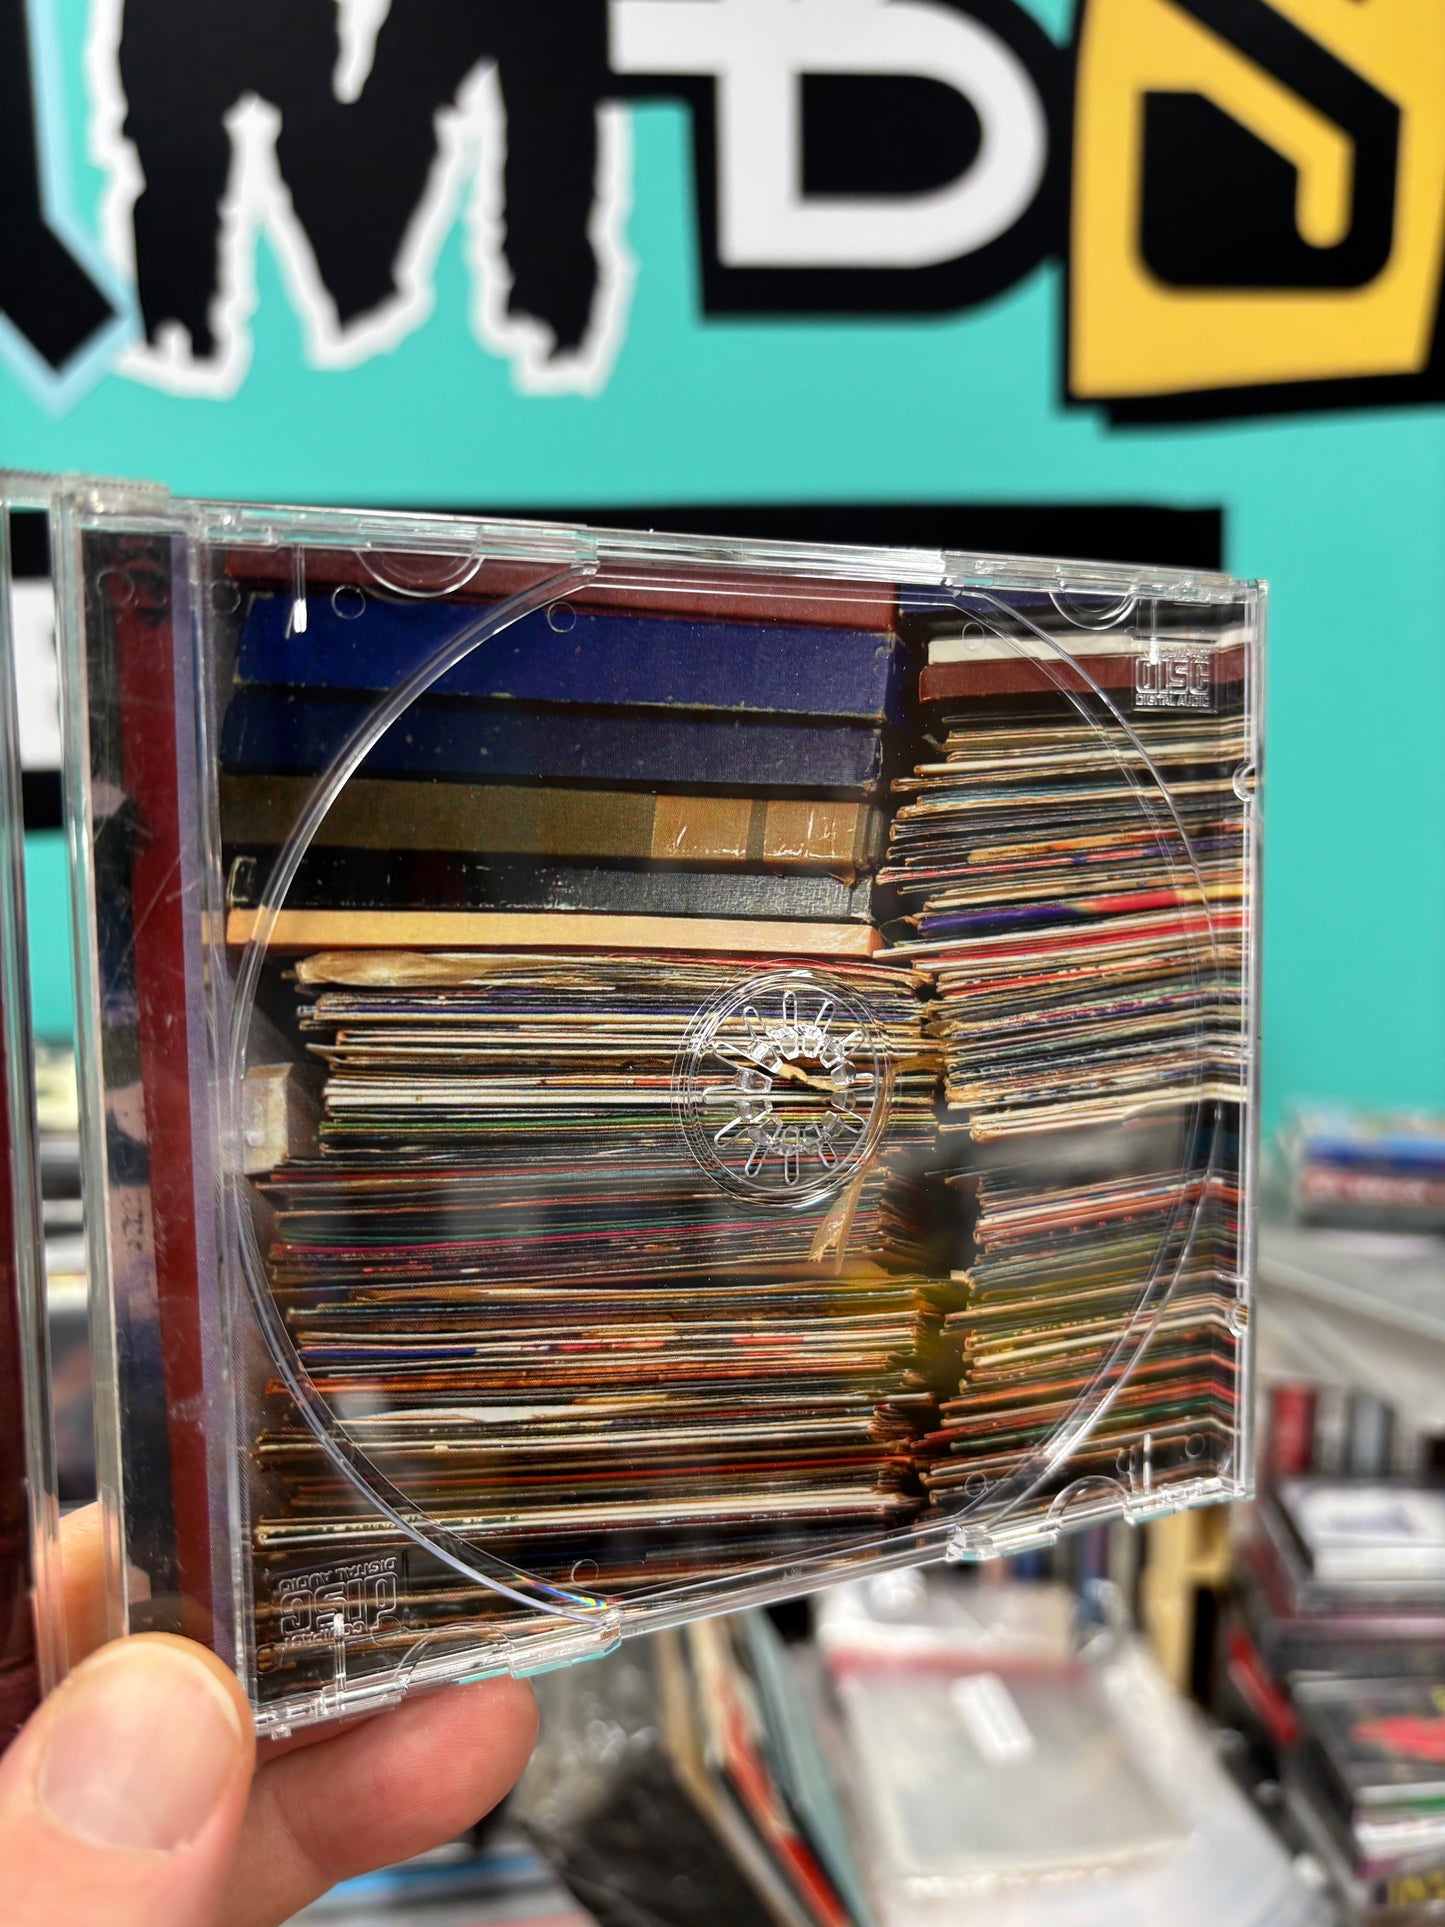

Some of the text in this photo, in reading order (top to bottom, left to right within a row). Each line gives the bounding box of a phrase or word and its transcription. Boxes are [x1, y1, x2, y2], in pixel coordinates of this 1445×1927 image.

[1136, 693, 1211, 707] DIGITAL AUDIO
[278, 1556, 397, 1593] DIGITAL AUDIO
